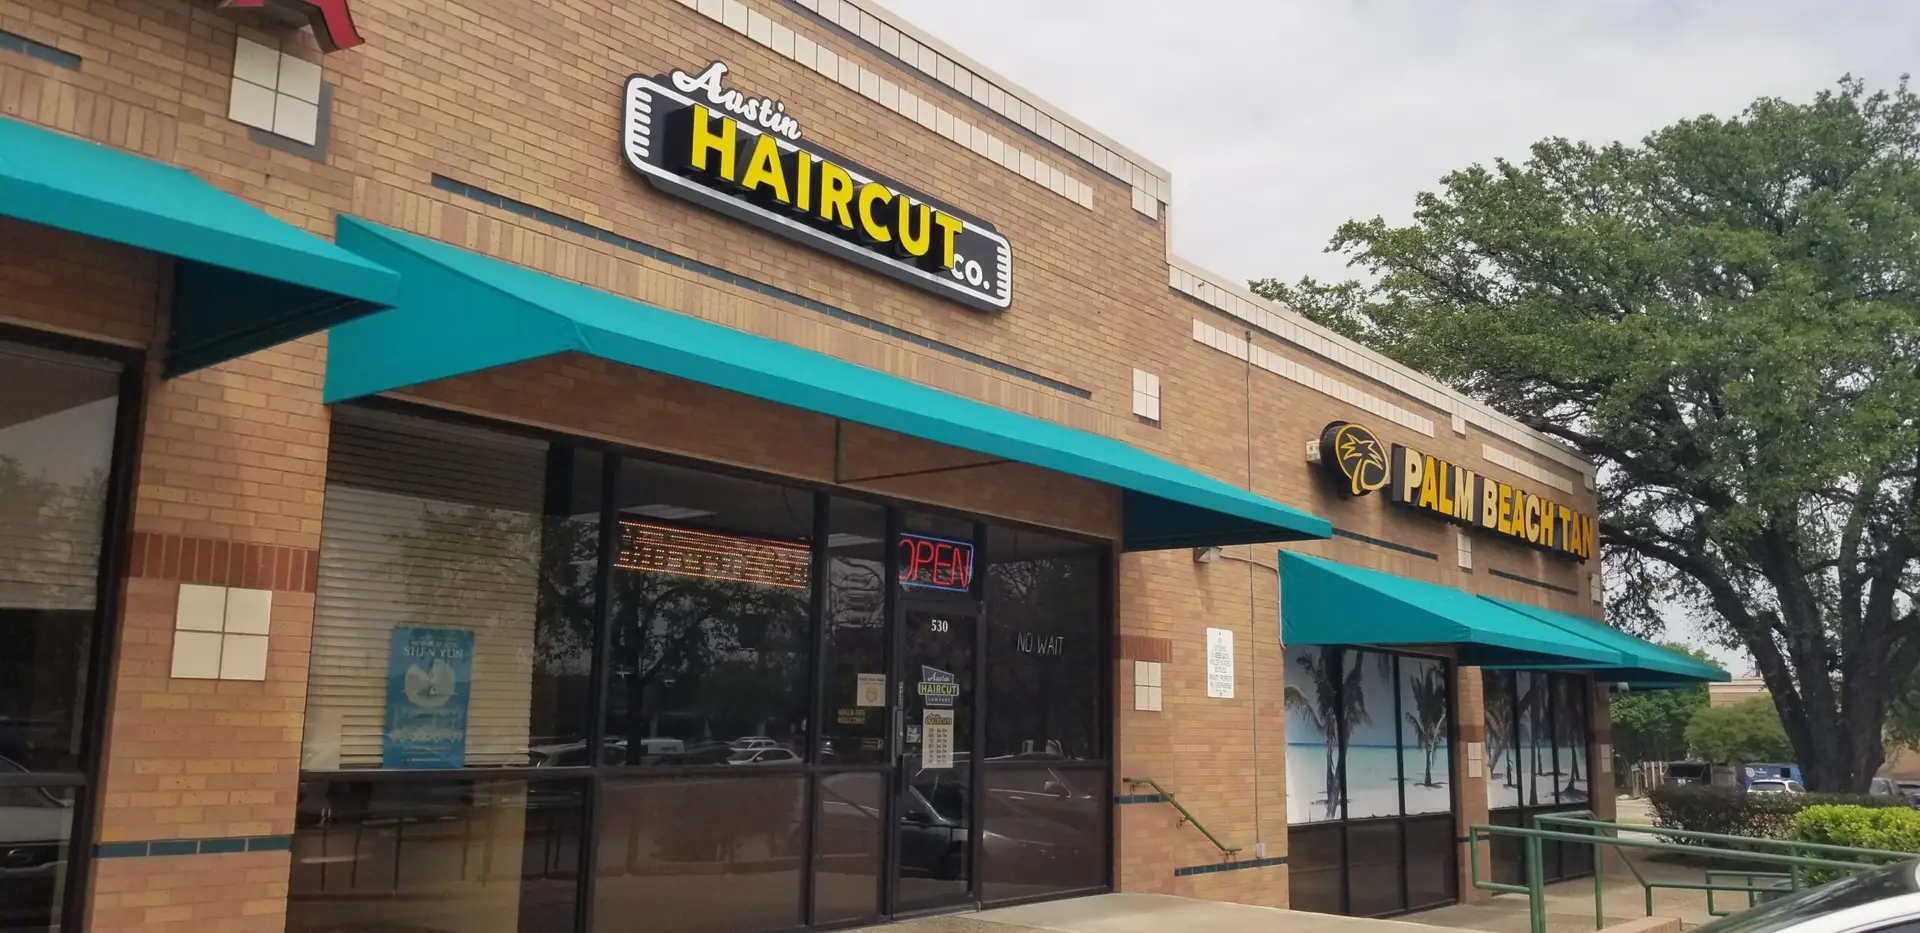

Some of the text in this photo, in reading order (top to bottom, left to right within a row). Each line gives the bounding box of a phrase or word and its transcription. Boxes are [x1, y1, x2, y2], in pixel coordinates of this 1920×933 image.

[671, 61, 802, 140] Austin
[691, 104, 963, 269] HAIRCUT
[1403, 446, 1596, 560] PALM BEACH TAN
[899, 538, 970, 588] OPEN
[931, 619, 949, 633] 530
[1017, 631, 1064, 656] NO WAIT
[921, 684, 957, 694] HAIRCUT
